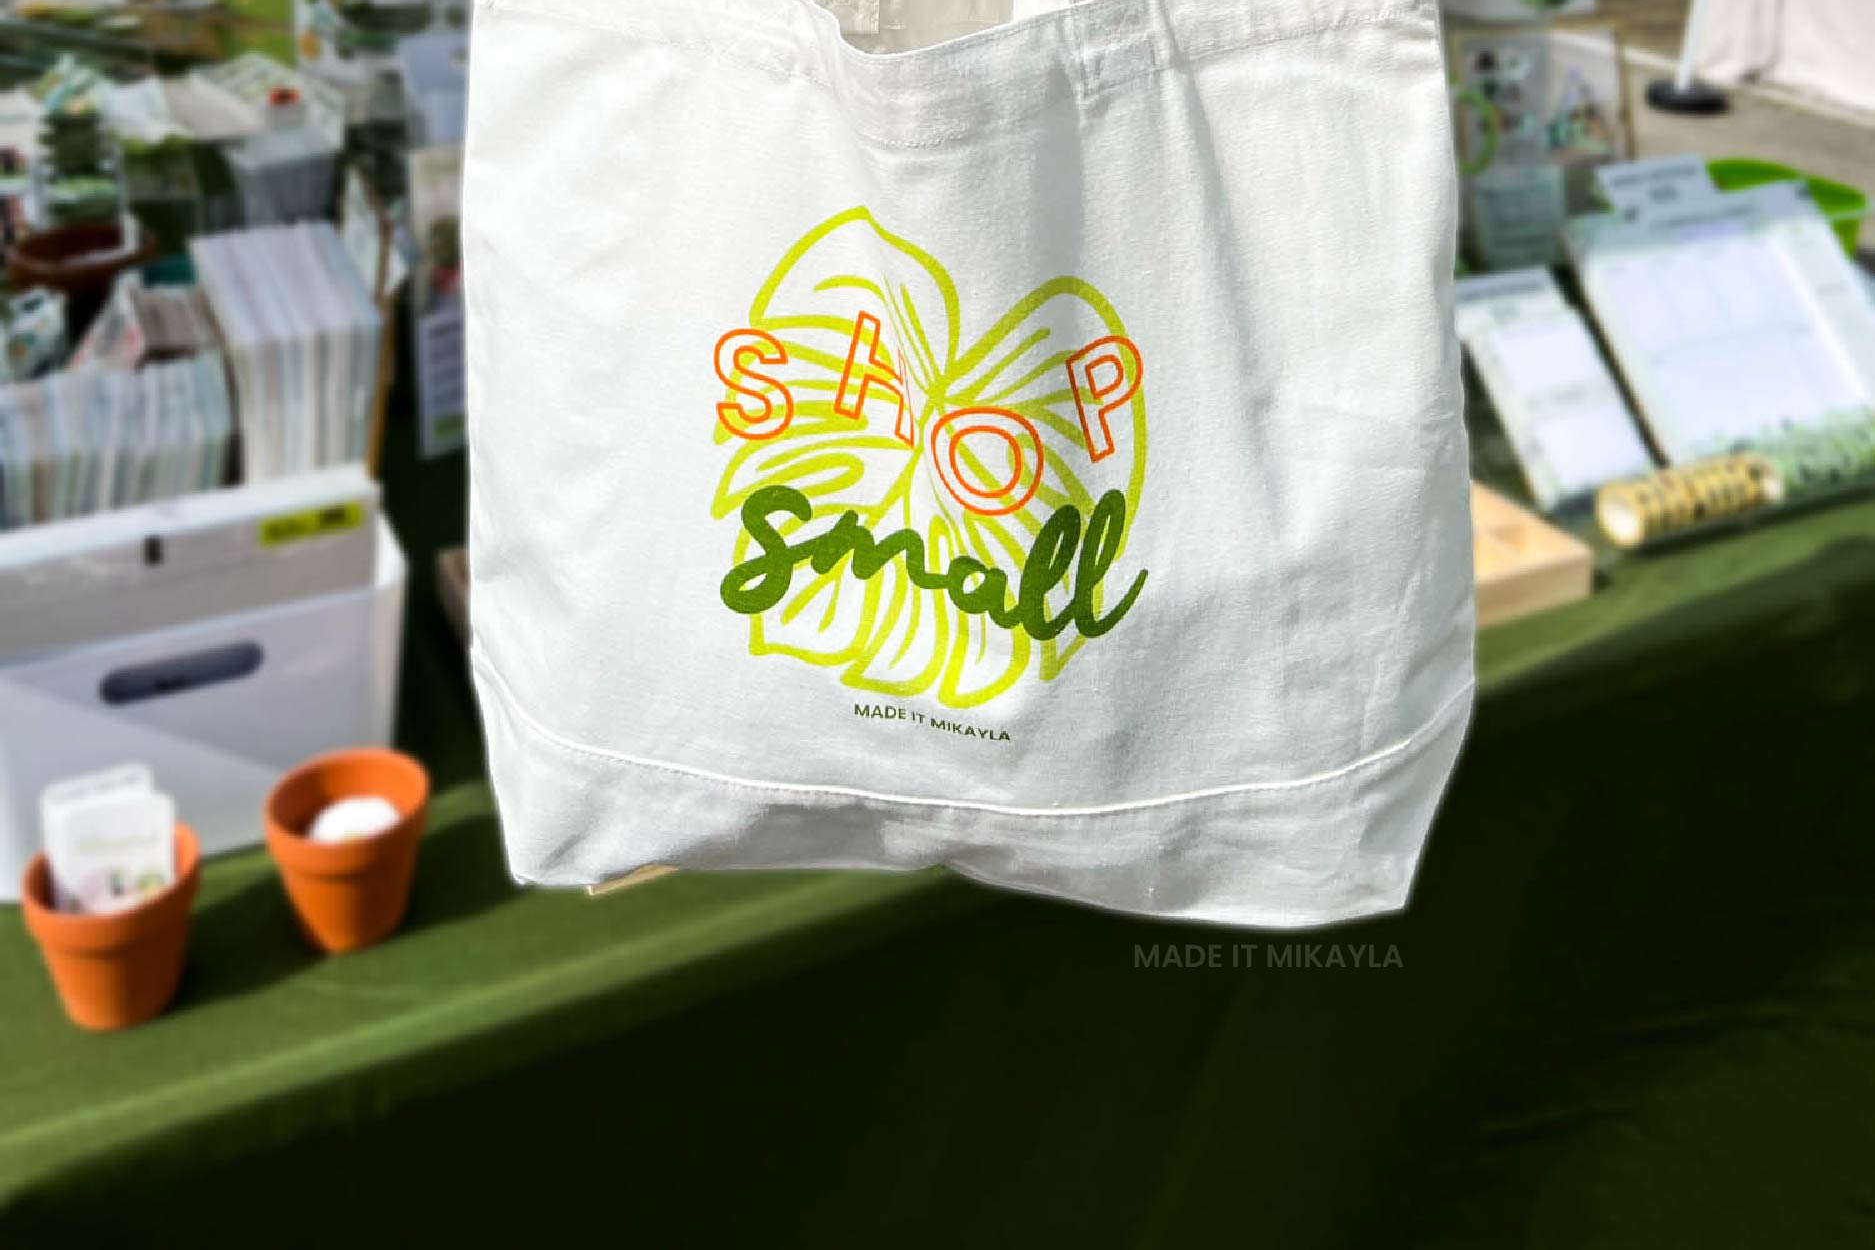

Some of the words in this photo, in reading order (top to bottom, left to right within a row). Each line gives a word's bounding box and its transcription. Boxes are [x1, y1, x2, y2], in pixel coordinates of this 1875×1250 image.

[713, 310, 1144, 517] SHOP
[854, 703, 906, 720] MADE
[911, 711, 925, 724] IT
[930, 718, 1010, 741] MIKAYLA
